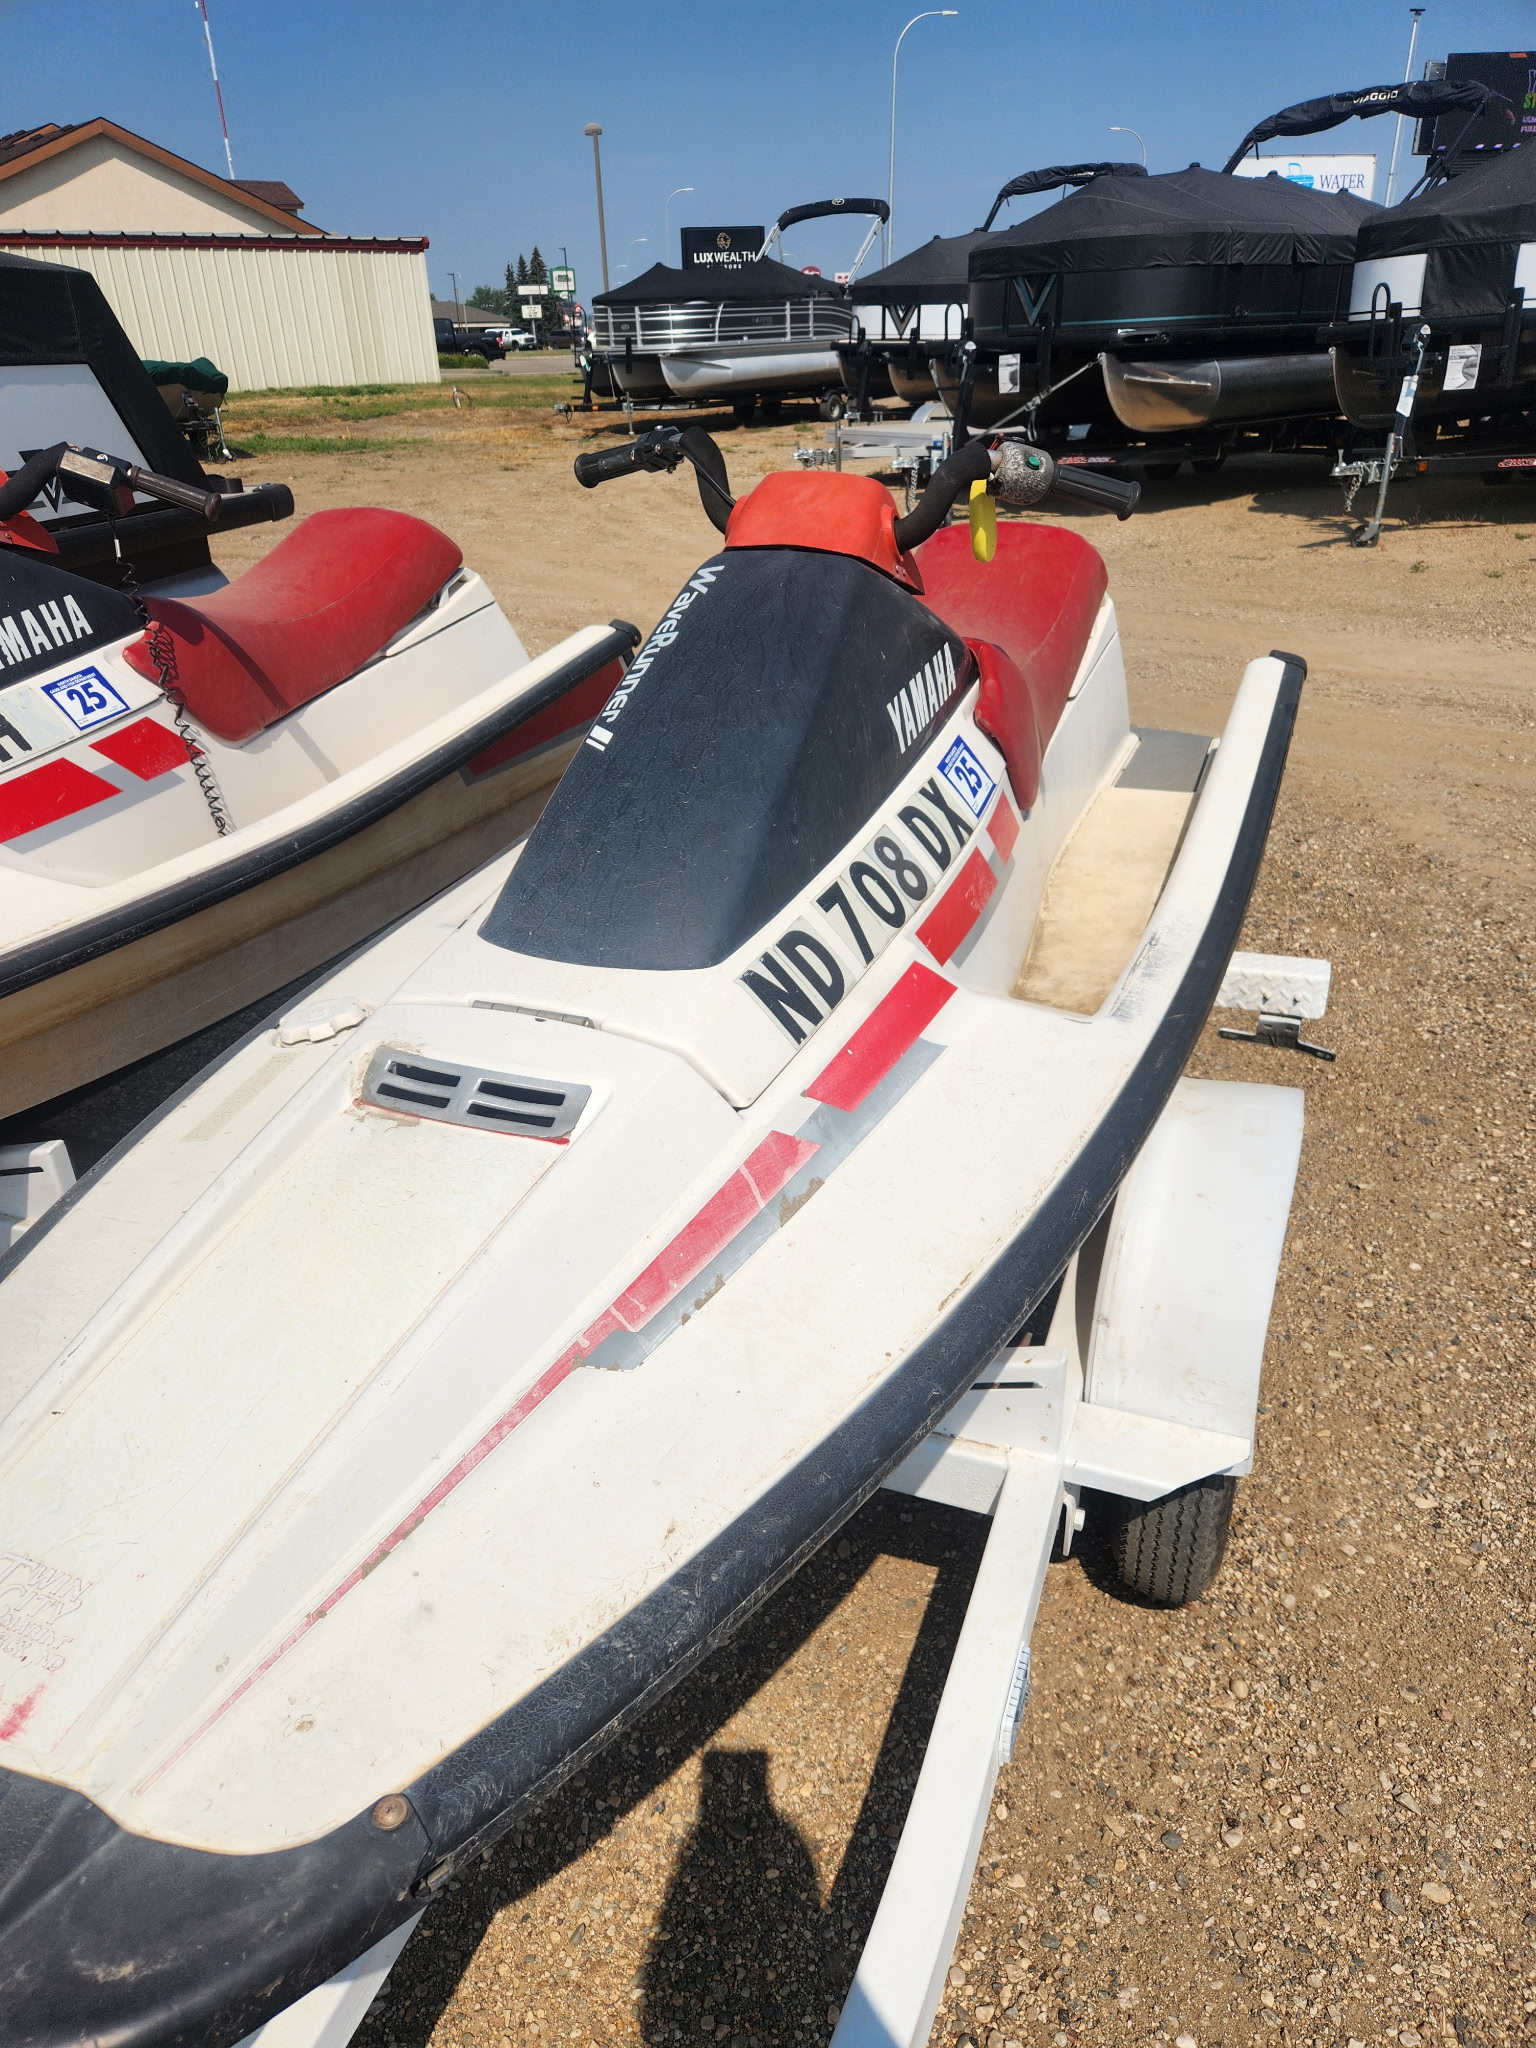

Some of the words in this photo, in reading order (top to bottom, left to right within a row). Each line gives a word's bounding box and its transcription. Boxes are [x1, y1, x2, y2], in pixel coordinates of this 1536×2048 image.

[1319, 173, 1366, 190] WATER
[0, 594, 94, 670] MAHA
[601, 565, 726, 723] WaveRunner
[66, 682, 108, 716] 25
[886, 641, 957, 755] YAMAHA
[954, 755, 983, 799] 25
[739, 929, 845, 1046] ND
[815, 835, 928, 968] 708
[897, 776, 974, 873] DX
